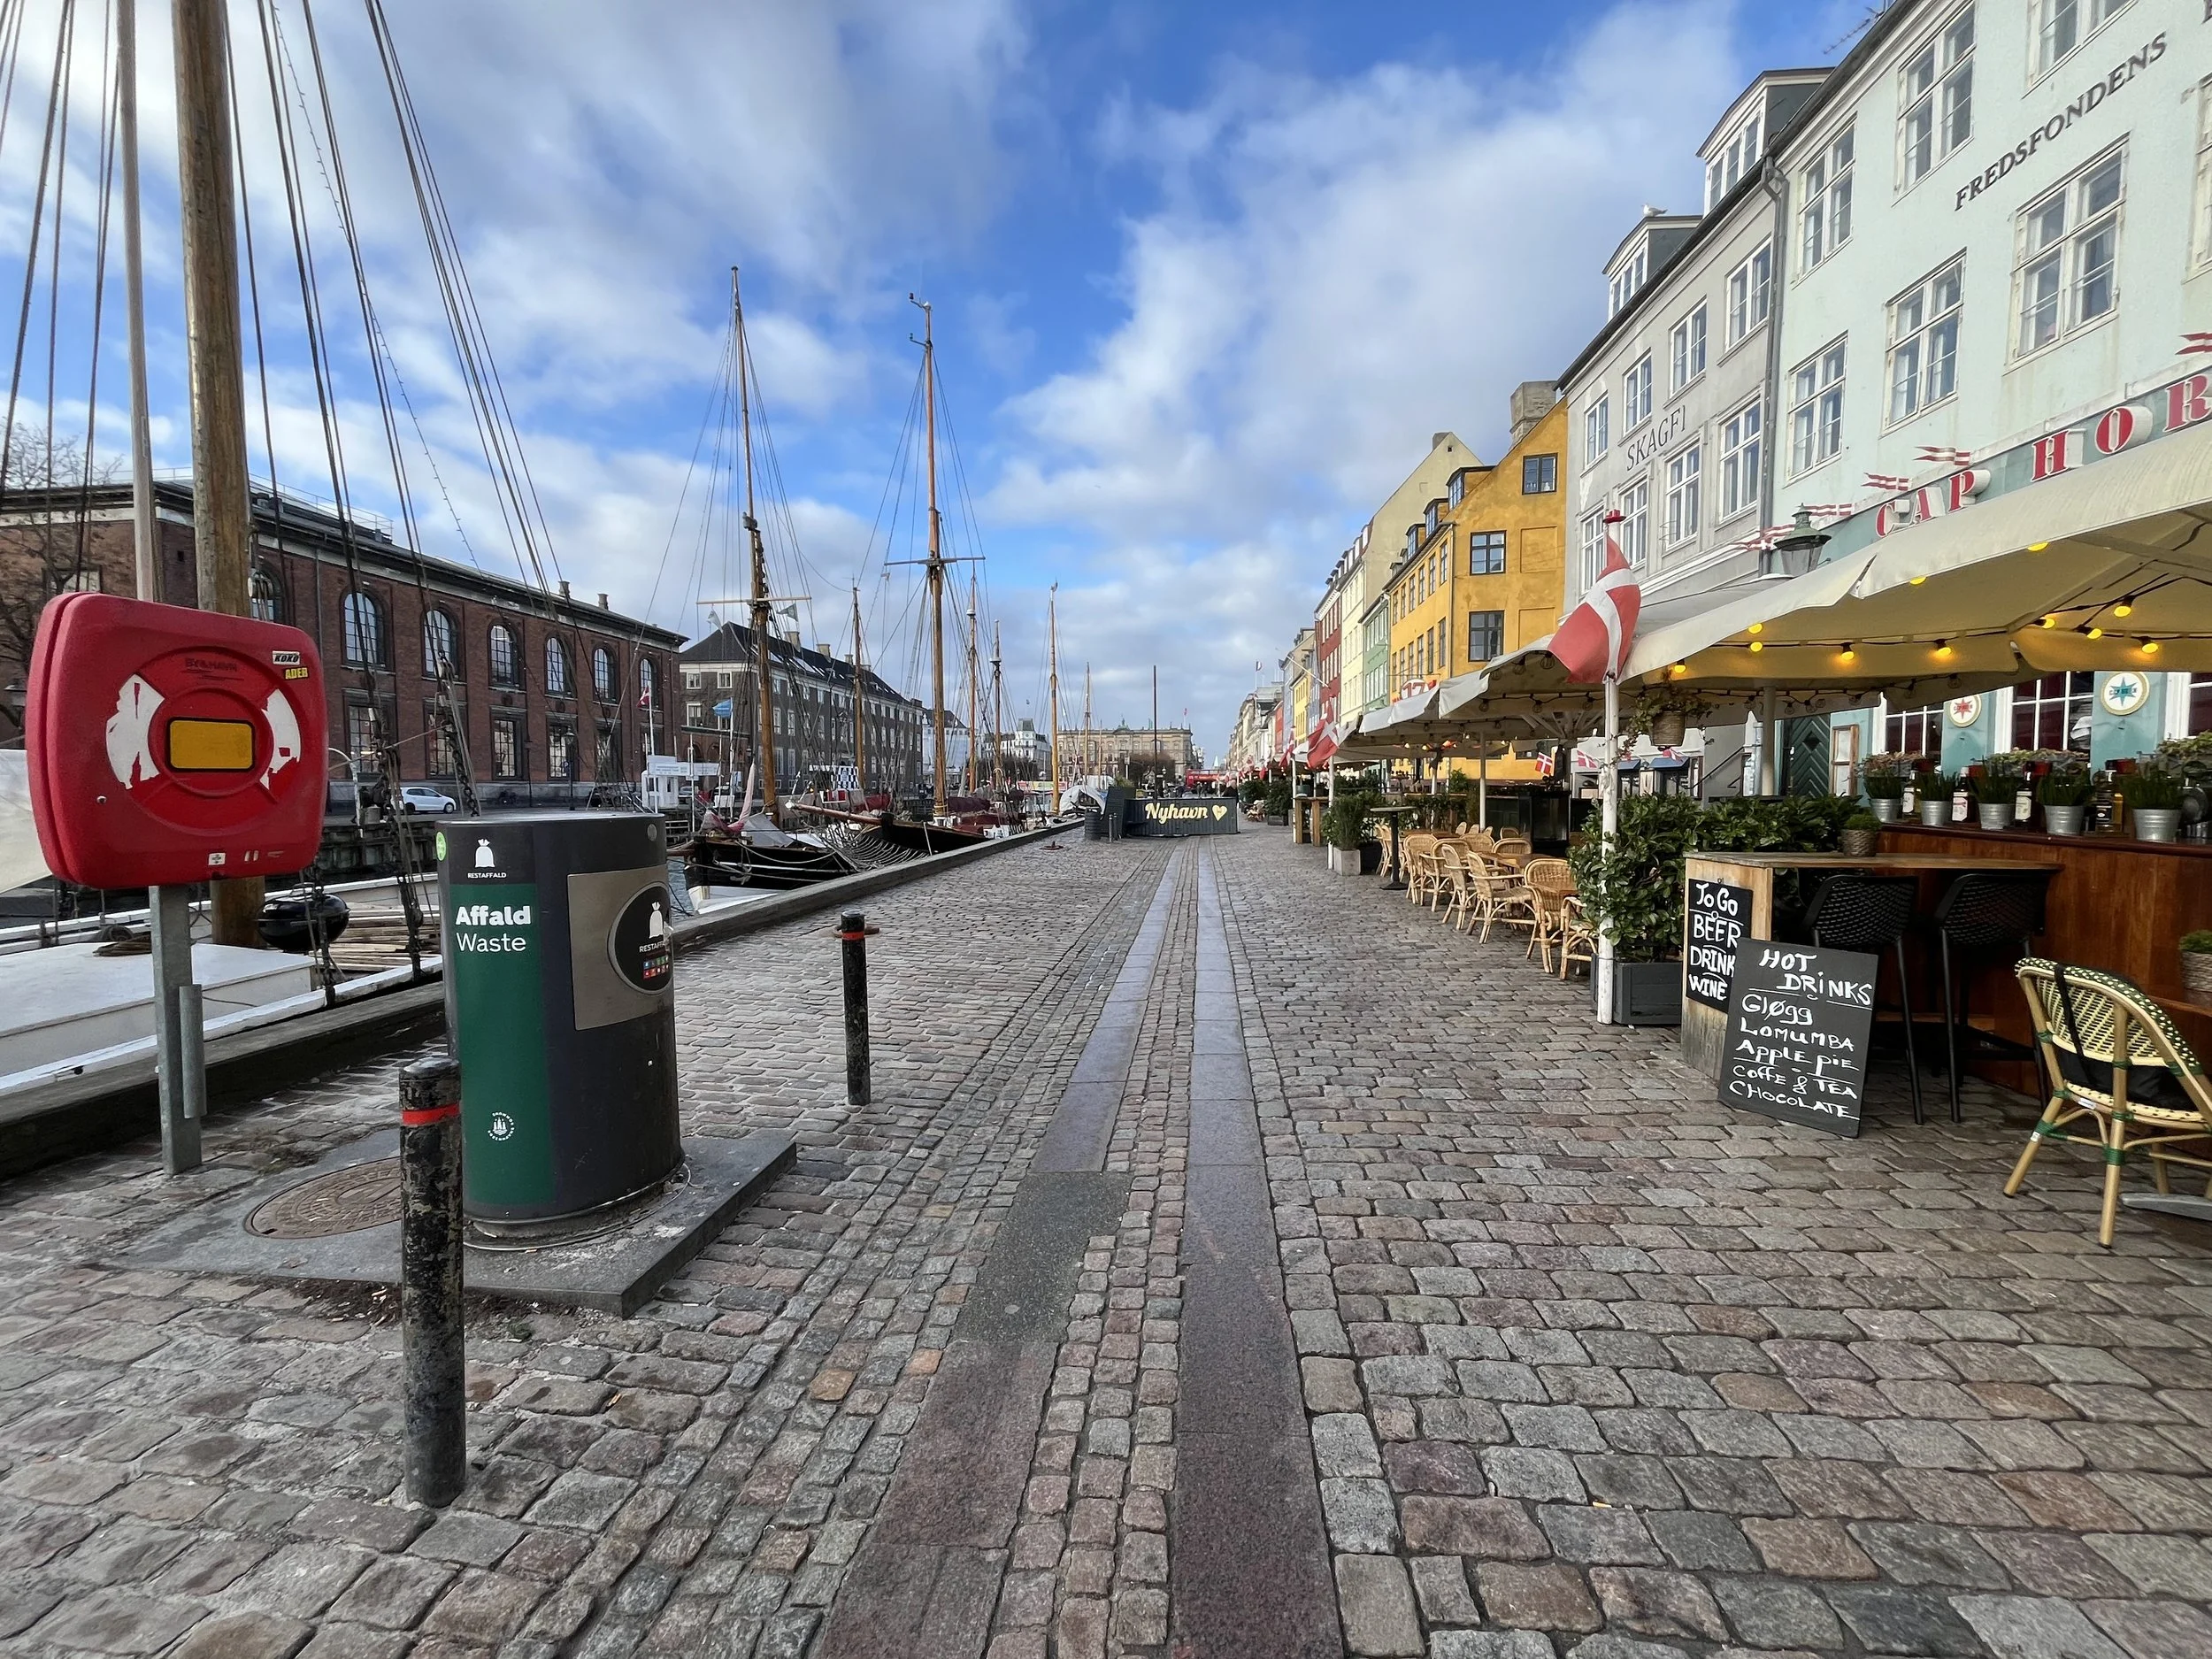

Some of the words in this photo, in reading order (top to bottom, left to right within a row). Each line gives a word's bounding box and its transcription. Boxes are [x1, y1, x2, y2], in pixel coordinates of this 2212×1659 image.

[1954, 30, 2168, 211] FREDSFONDENS
[1875, 469, 1977, 538] CAP
[274, 653, 299, 663] KOKO
[1144, 802, 1209, 825] Nyhavn
[1717, 887, 1739, 917] Go
[455, 905, 531, 926] Affald
[456, 932, 526, 952] Waste
[1693, 913, 1742, 949] BEER
[1758, 949, 1817, 972] HOT
[1688, 973, 1728, 1002] WINE
[1729, 1080, 1861, 1121] CHOCOLATE
[1812, 1078, 1858, 1100] TEA
